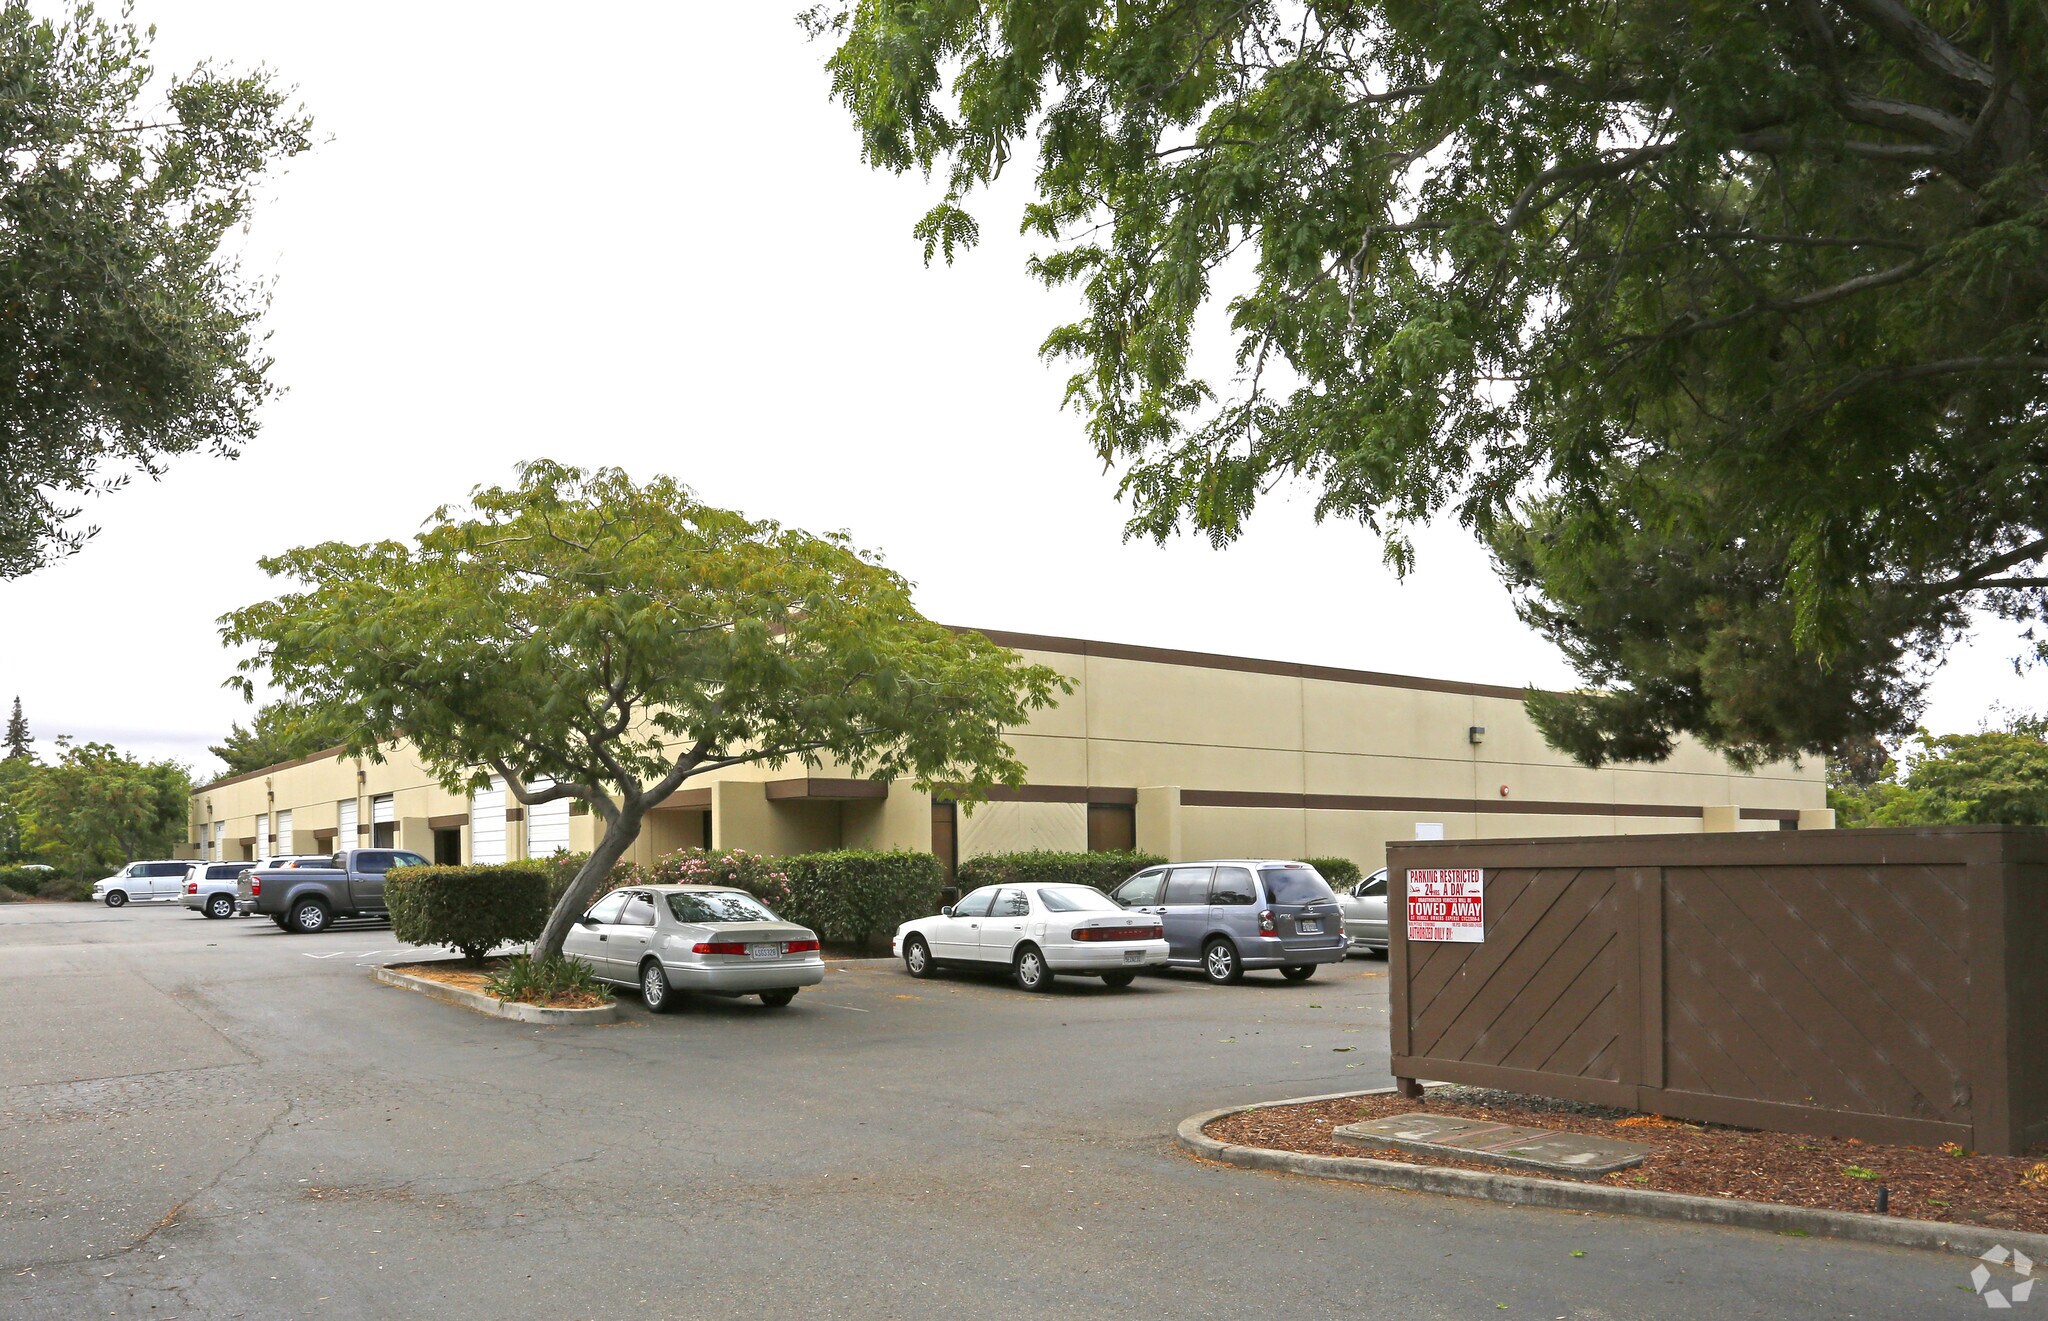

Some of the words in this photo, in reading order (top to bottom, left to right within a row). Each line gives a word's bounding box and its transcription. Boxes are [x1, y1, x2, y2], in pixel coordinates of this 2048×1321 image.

[1410, 870, 1438, 883] PARKING
[1440, 870, 1479, 883] RESTRICTED
[1443, 884, 1448, 895] A
[1451, 883, 1464, 895] DAY
[1409, 903, 1446, 915] TOWED
[1451, 903, 1481, 916] AWAY
